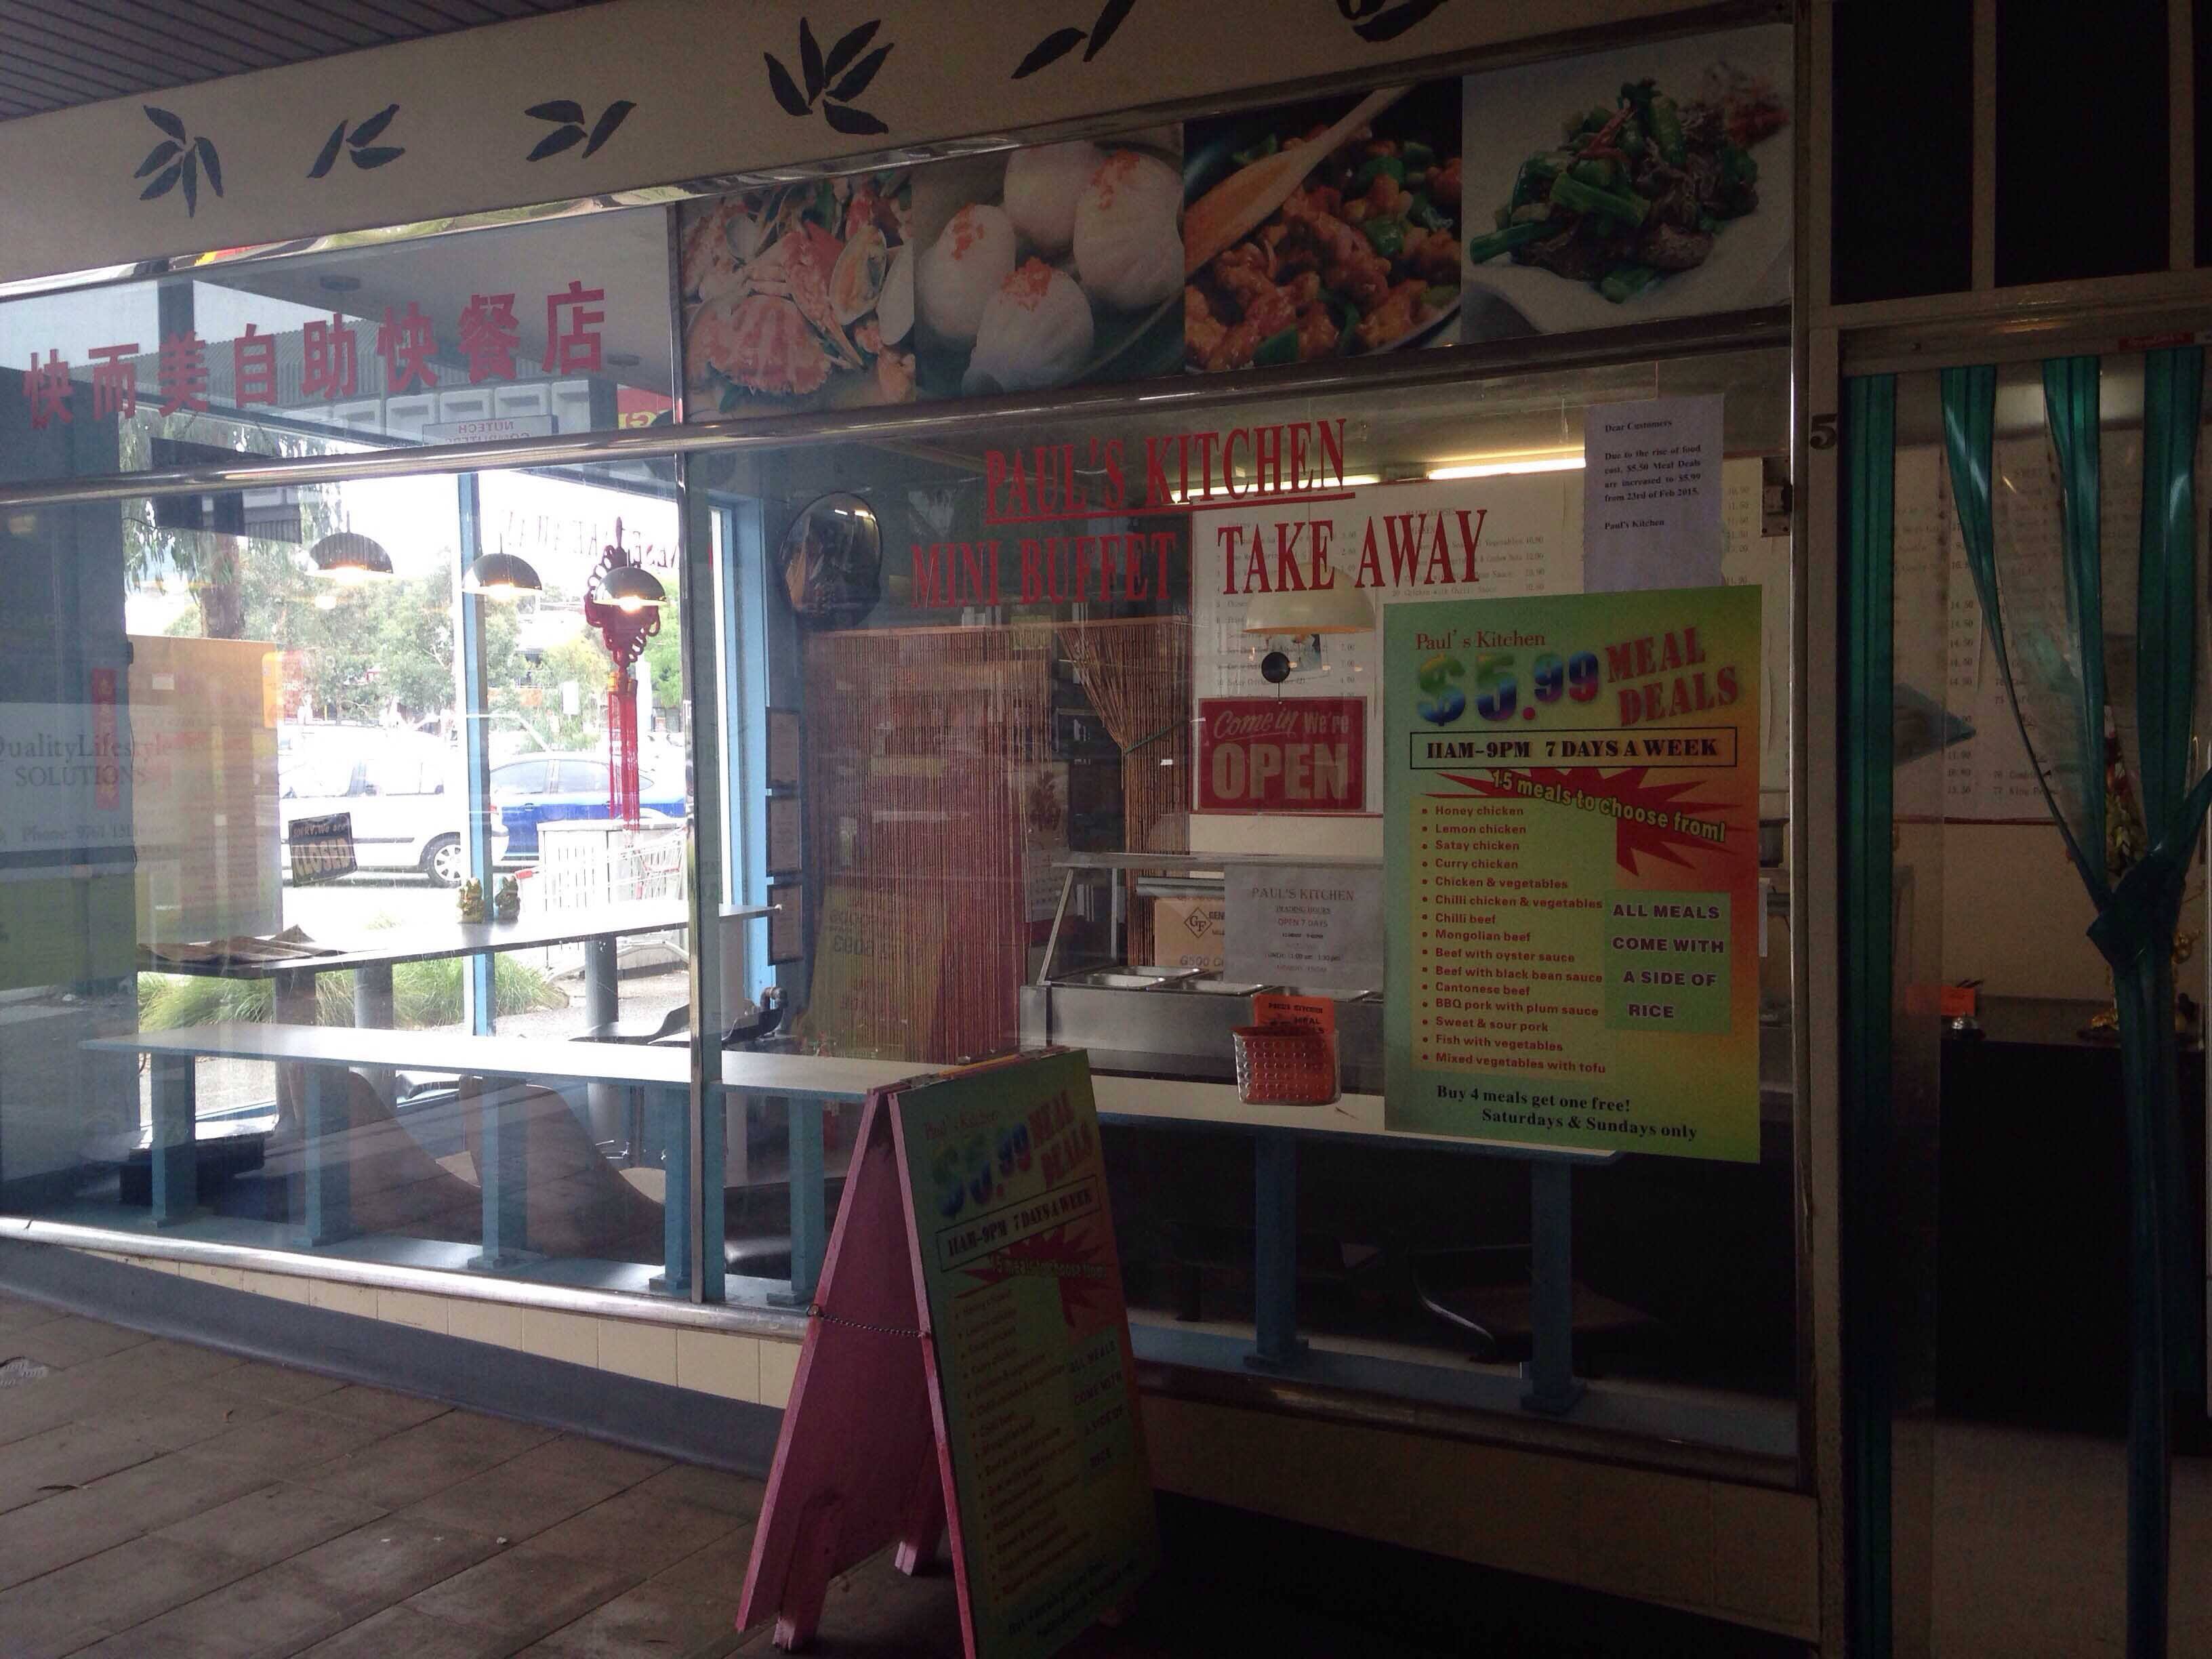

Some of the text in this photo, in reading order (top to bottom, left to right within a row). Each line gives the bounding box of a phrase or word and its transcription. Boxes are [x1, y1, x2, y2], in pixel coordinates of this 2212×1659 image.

[23, 281, 606, 430] 快而美自助快餐店
[1605, 420, 1672, 432] Dear Customers
[1682, 445, 1701, 453] food
[984, 417, 1347, 519] PAUL'S KITCHEN
[1622, 477, 1660, 487] increased
[1605, 494, 1624, 502] from
[1605, 519, 1664, 530] Paul's Kitchen
[1217, 520, 1335, 594] TAKE
[1354, 509, 1488, 588] AWAY
[911, 533, 1176, 609] MINI BUFFET
[1475, 630, 1546, 649] Kitchen
[1604, 627, 1706, 683] MEAL
[1416, 651, 1600, 727] $5.99
[1618, 665, 1739, 726] DEALS
[1214, 707, 1349, 739] Come in We're
[1546, 741, 1556, 758] 7
[1561, 740, 1618, 758] DAYS
[1624, 740, 1639, 757] A
[1642, 738, 1717, 756] WEEK
[1212, 743, 1348, 800] OPEN
[1435, 806, 1523, 817] Honey chicken
[1492, 769, 1726, 842] 15 meals to choose from!
[1435, 824, 1526, 834] Lemon chicken
[1435, 840, 1519, 851] Satay chicken
[1435, 858, 1518, 869] Curry chicken
[1435, 876, 1568, 889] Chicken & vegetables
[1435, 895, 1603, 909] Chilli chicken & vegetables
[1435, 913, 1496, 924] Chilli beef
[1613, 904, 1719, 919] ALL MEALS
[1435, 929, 1531, 942] Mongolian beef
[1612, 937, 1724, 953] COME WITH
[1435, 947, 1575, 962] Beef with oyster sauce
[1435, 966, 1603, 983] Beef with black bean sauce
[1623, 970, 1717, 986] A SIDE OF
[1435, 982, 1530, 996] Cantonese beef
[1436, 998, 1599, 1016] BBQ pork with plum sauce
[1629, 1004, 1674, 1018] RICE
[1436, 1017, 1548, 1032] Sweet & sour pork
[1436, 1034, 1563, 1051] Fish with vegetables
[1436, 1053, 1605, 1073] Mixed vegetables with tofu
[1437, 1084, 1631, 1112] Buy 4 meals get one free!
[1481, 1108, 1696, 1140] Saturdays & Sundays only
